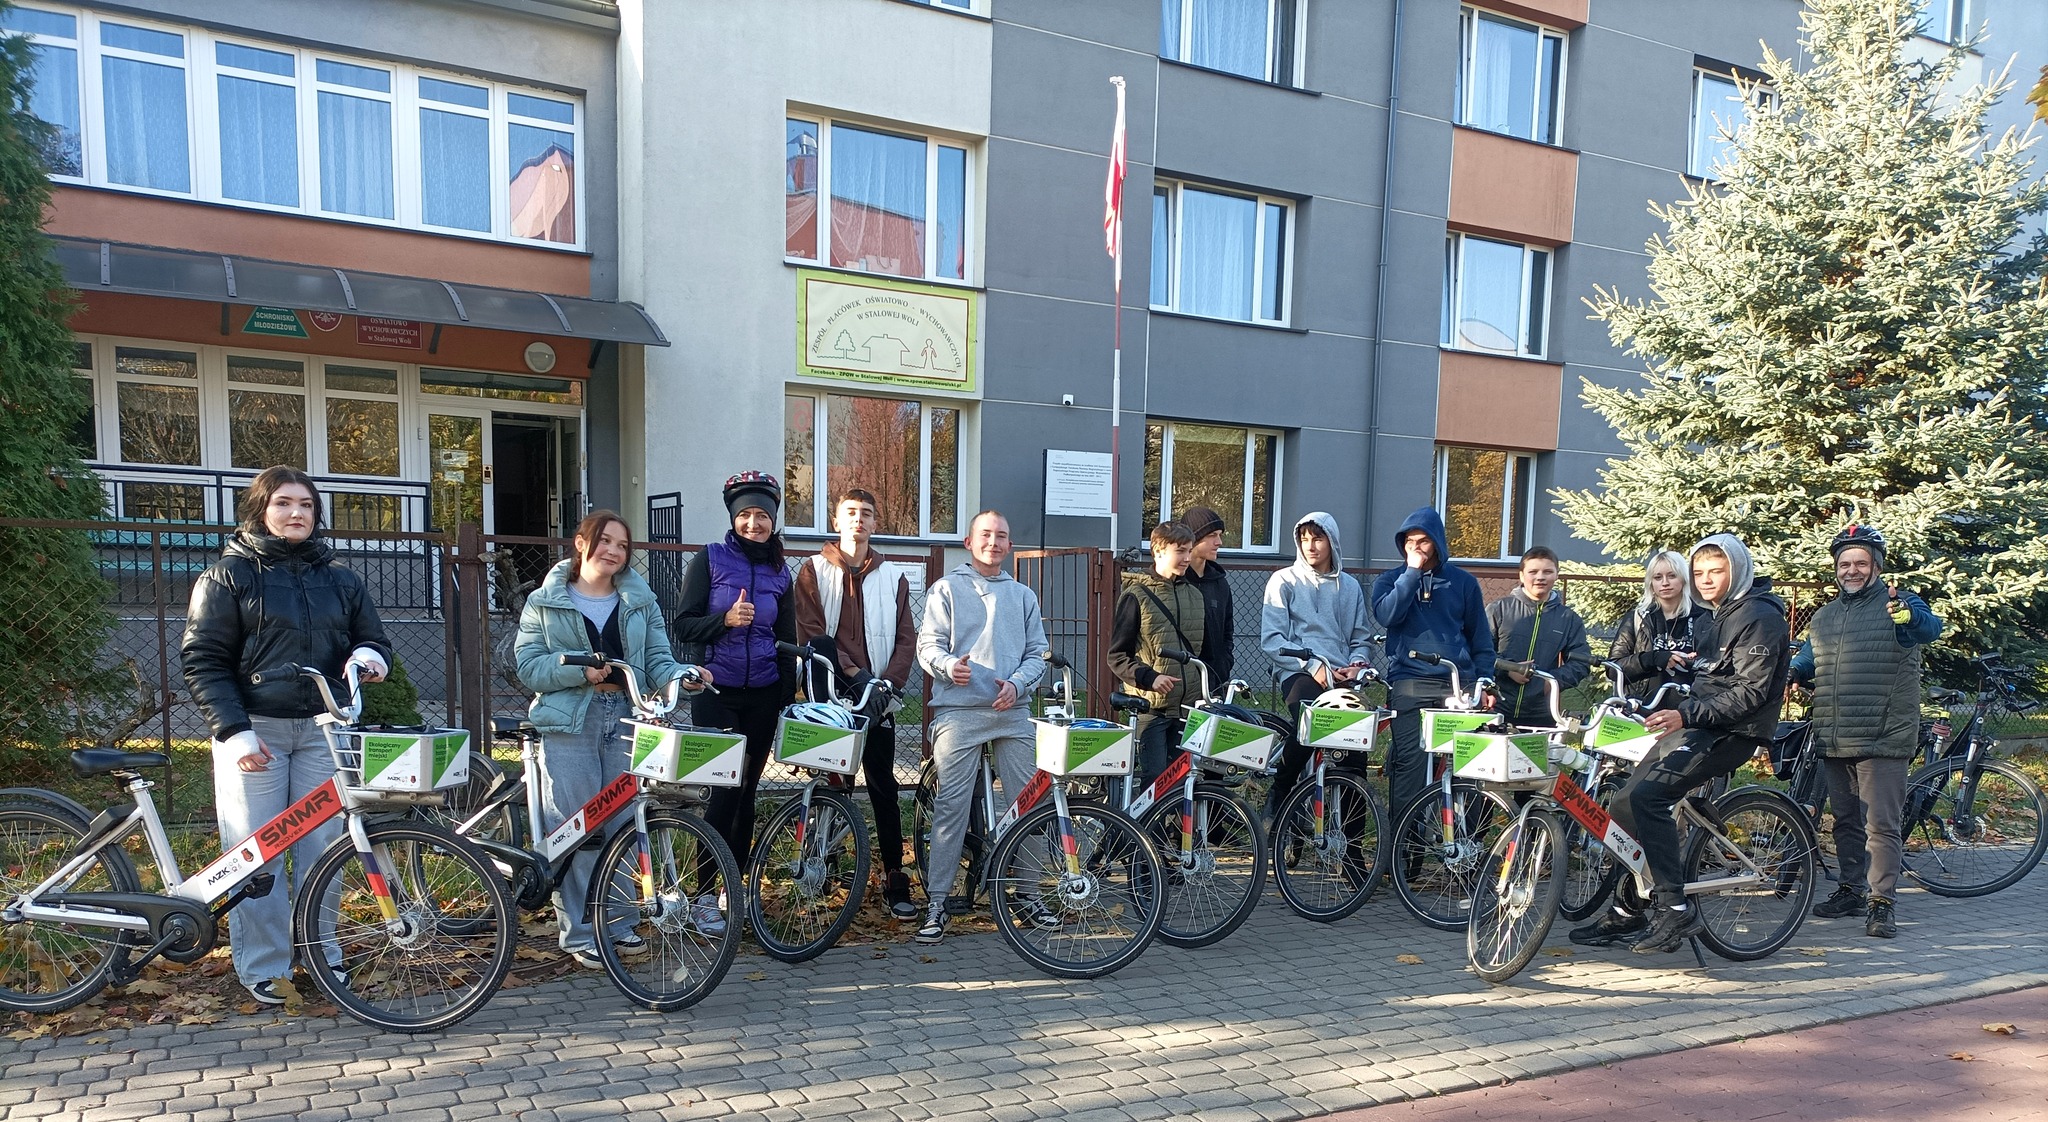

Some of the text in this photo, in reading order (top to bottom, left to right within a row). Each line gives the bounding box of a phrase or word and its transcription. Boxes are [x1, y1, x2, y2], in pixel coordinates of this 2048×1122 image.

[254, 322, 297, 332] MŁODZIEŻOWE
[256, 312, 294, 322] SCHRONISKO
[865, 310, 900, 320] STALOWEJ
[901, 313, 919, 327] WOLI
[374, 335, 397, 344] Stalowej
[812, 327, 828, 354] ZESPÓŁ
[827, 300, 861, 326] PLACÓWEK
[865, 295, 909, 308] OŚWIATOWO
[919, 308, 962, 368] WYCHOWAWCZYCH
[1157, 754, 1188, 790] SWMR
[586, 774, 633, 819] SWMR
[1020, 770, 1047, 810] SWMR
[1559, 781, 1606, 827] SWMR
[260, 790, 334, 847] SWMR
[552, 832, 566, 847] MZK
[1611, 831, 1626, 846] MZK
[208, 866, 230, 886] MZK
